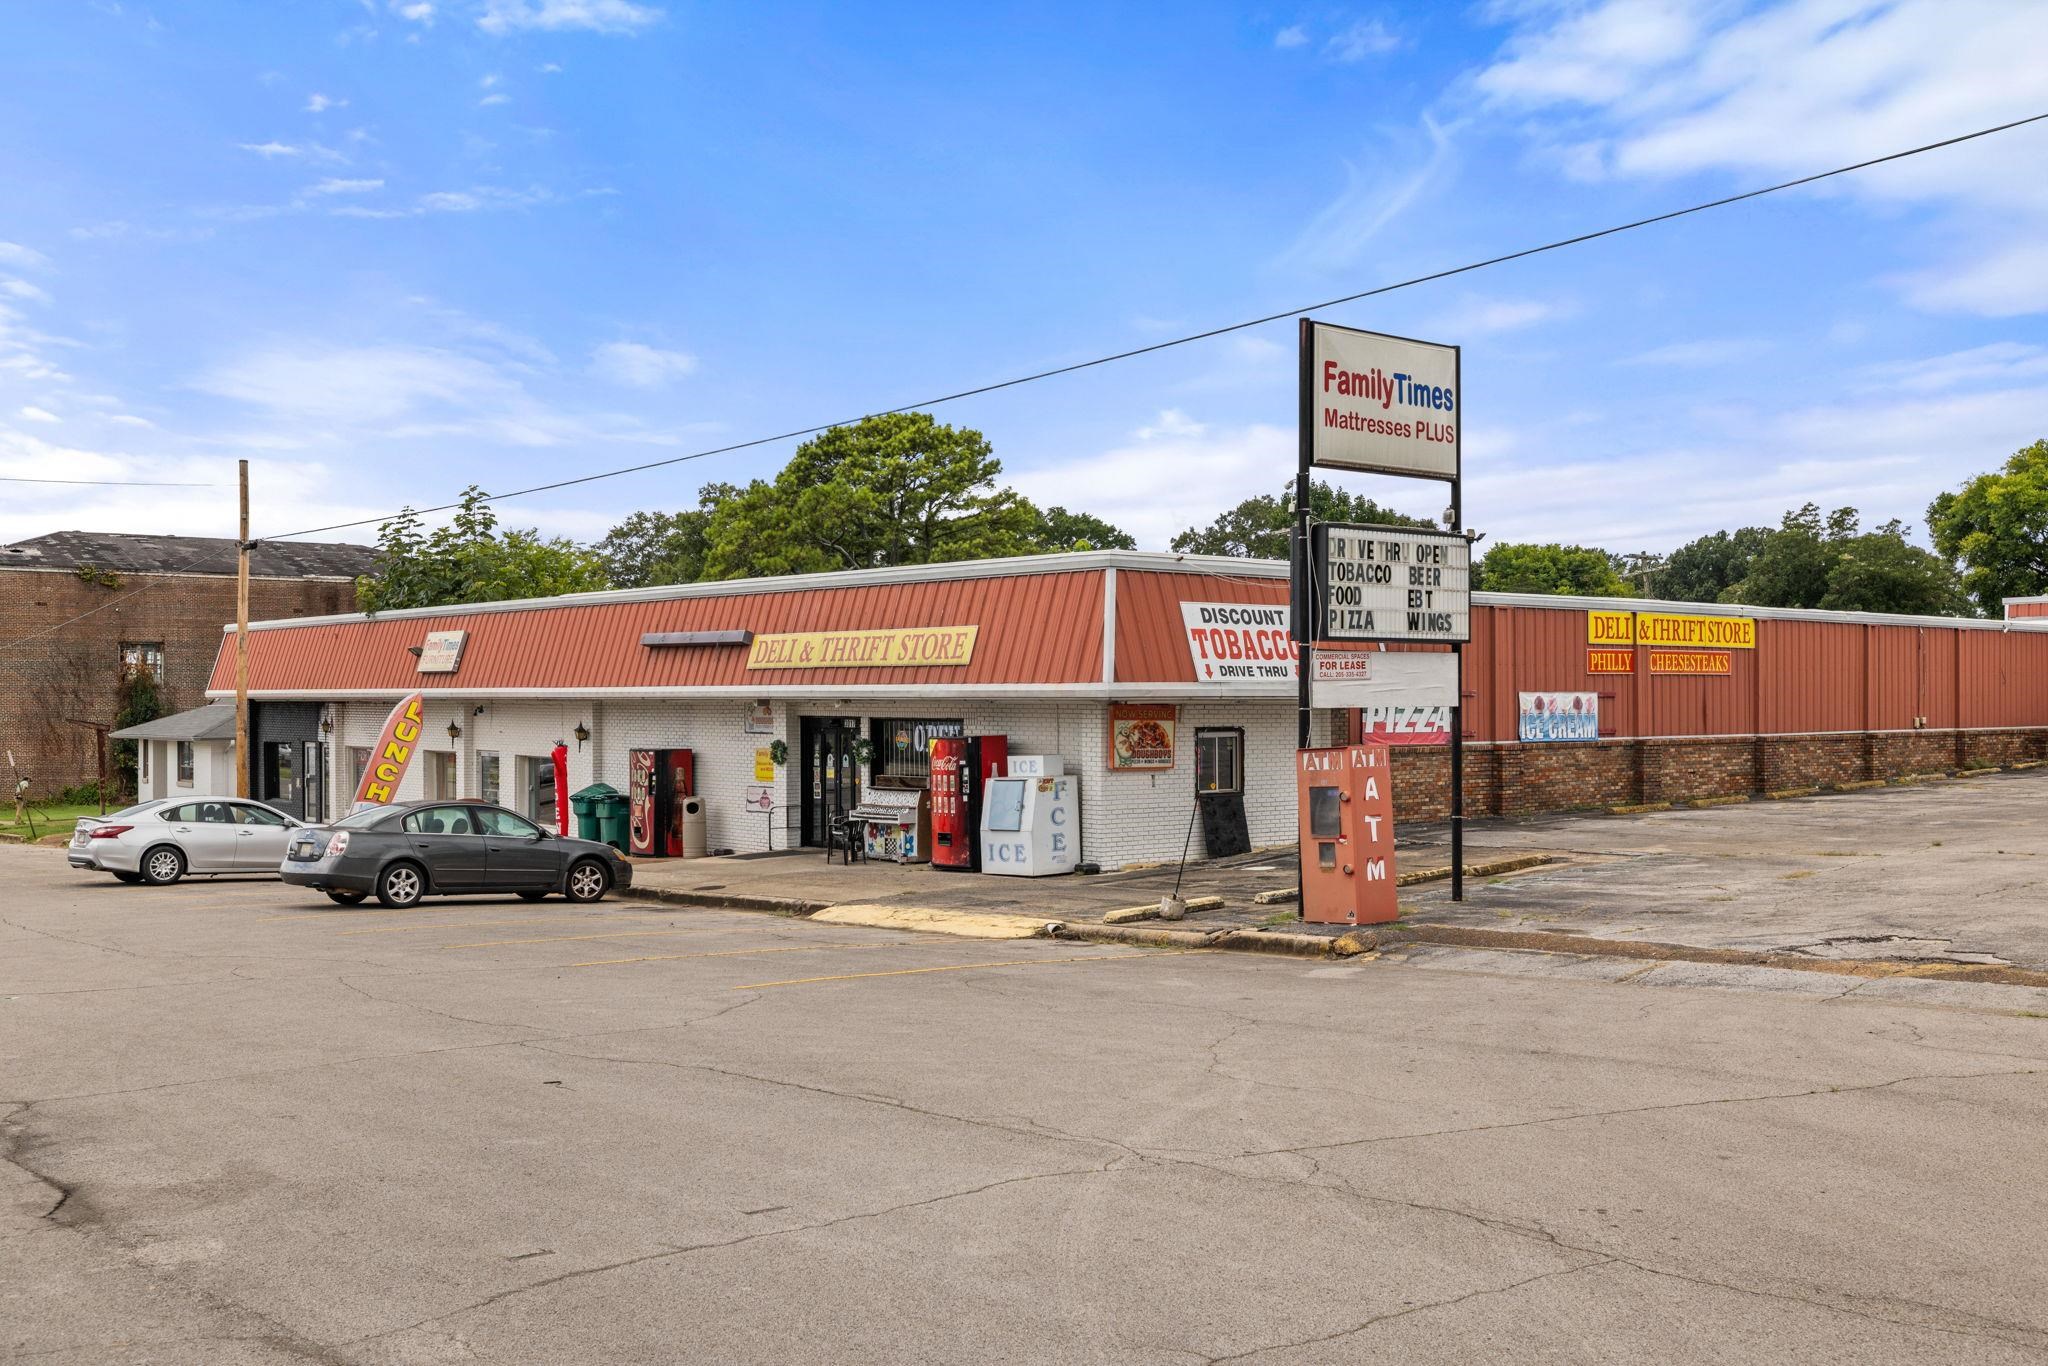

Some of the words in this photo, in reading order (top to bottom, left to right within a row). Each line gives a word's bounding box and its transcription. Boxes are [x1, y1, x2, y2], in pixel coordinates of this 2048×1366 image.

[1324, 408, 1411, 438] Mattresses
[1416, 421, 1454, 444] PLUS
[1416, 544, 1448, 564] OPEN
[1329, 561, 1391, 584] TOBACCO
[1409, 566, 1440, 586] BEER
[1328, 585, 1362, 606] FOOD
[1200, 607, 1284, 625] DISCOUNT
[1329, 609, 1375, 630] PIZZA
[1407, 612, 1452, 632] WINGS
[1594, 616, 1630, 640] DELI
[1639, 620, 1650, 640] &
[1652, 618, 1705, 642] THRIFT
[1708, 621, 1751, 644] STORE
[754, 638, 798, 664] DELI
[800, 640, 815, 662] &
[820, 635, 895, 662] THRIFT
[898, 632, 968, 661] STORE
[1219, 665, 1255, 677] DRIVE
[1257, 666, 1289, 677] THRU
[1320, 661, 1337, 670] FOR
[1340, 661, 1366, 670] LEASE
[1590, 653, 1633, 671] PHILLY
[1650, 653, 1729, 672] CHEESESTEAKS
[1115, 710, 1135, 718] NOW
[1139, 710, 1172, 718] SERVING
[1365, 706, 1450, 733] PIZZA
[1521, 713, 1544, 740] ICE
[1548, 713, 1596, 740] CREAM
[363, 701, 422, 803] LUNCH
[1303, 752, 1343, 770] ATM
[1352, 749, 1386, 768] ATM
[1013, 759, 1037, 773] ICE
[988, 843, 1027, 863] ICE
